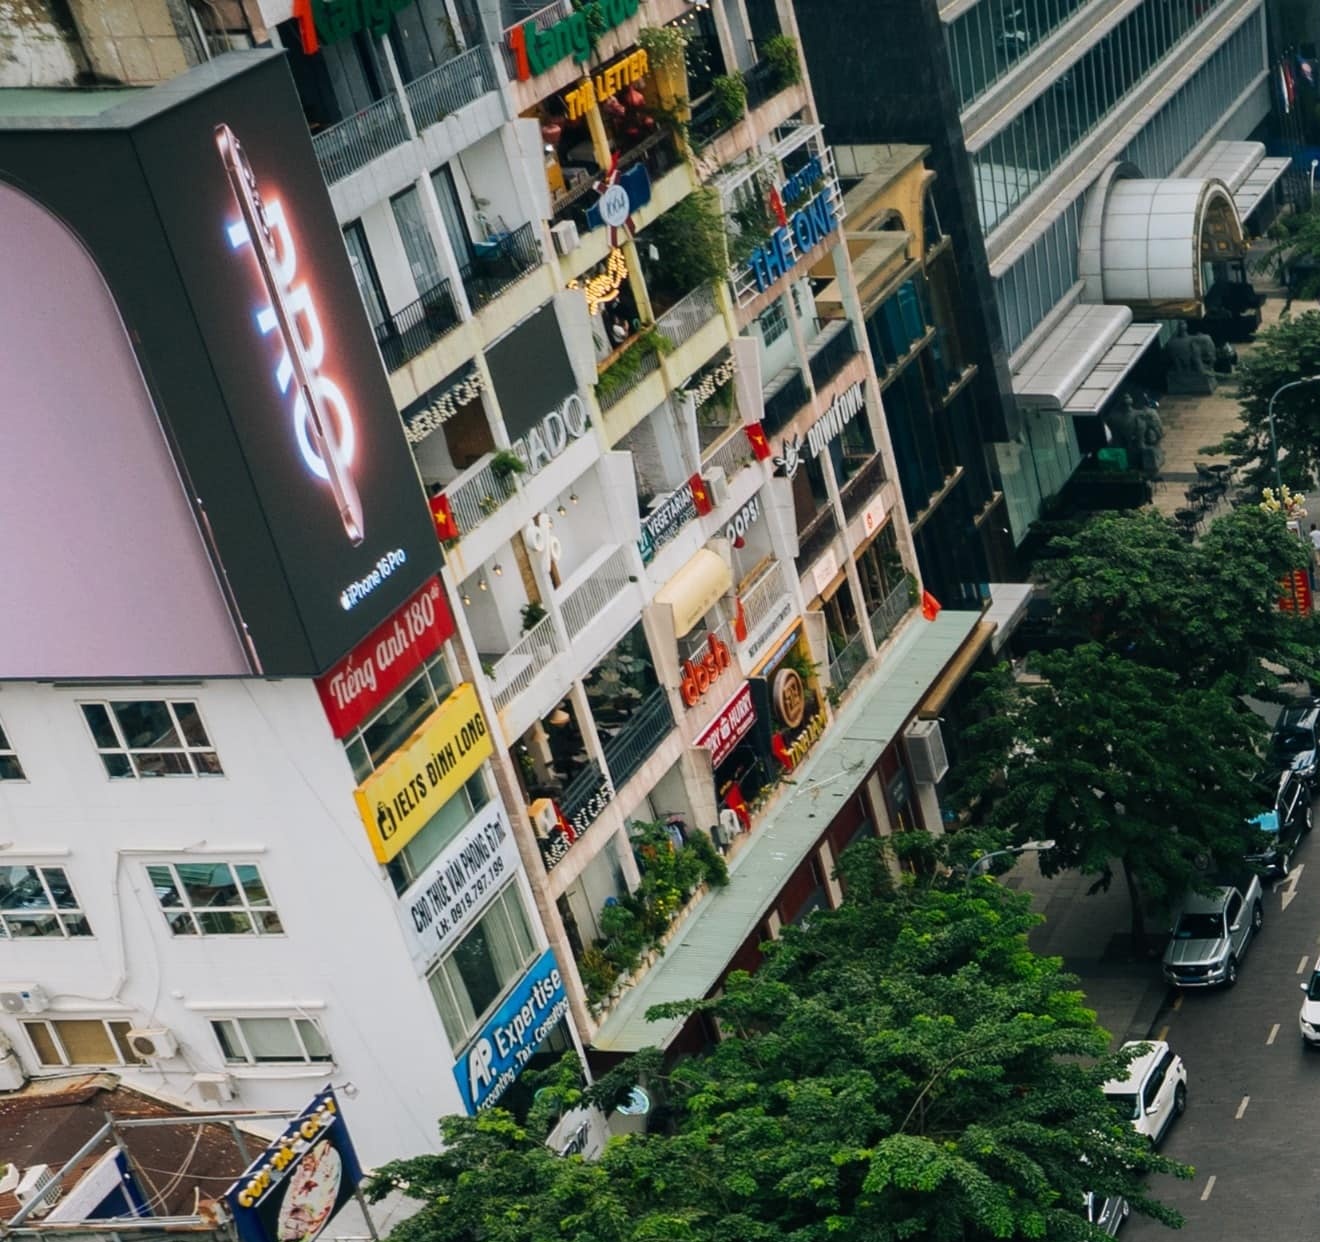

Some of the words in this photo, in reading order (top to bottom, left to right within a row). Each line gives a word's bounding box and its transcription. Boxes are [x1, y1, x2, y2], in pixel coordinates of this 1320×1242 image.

[596, 49, 648, 102] LETTER
[748, 225, 797, 293] THE
[792, 188, 838, 255] ONE
[647, 484, 694, 537] VEGETARIAN
[349, 566, 381, 607] iPhone
[380, 557, 391, 579] 16
[389, 548, 407, 571] Pro
[330, 654, 377, 710] Tiếng
[376, 627, 408, 672] anh
[405, 592, 435, 647] 180
[681, 633, 731, 707] dosh
[394, 773, 428, 821] IELTS
[427, 743, 457, 787] ĐÌNH
[455, 712, 486, 760] LONG
[411, 896, 431, 935] CHO
[459, 828, 488, 884] PHÒNG
[469, 1039, 497, 1100] AP.
[492, 966, 561, 1058] Expertise
[534, 993, 569, 1045] Consulting
